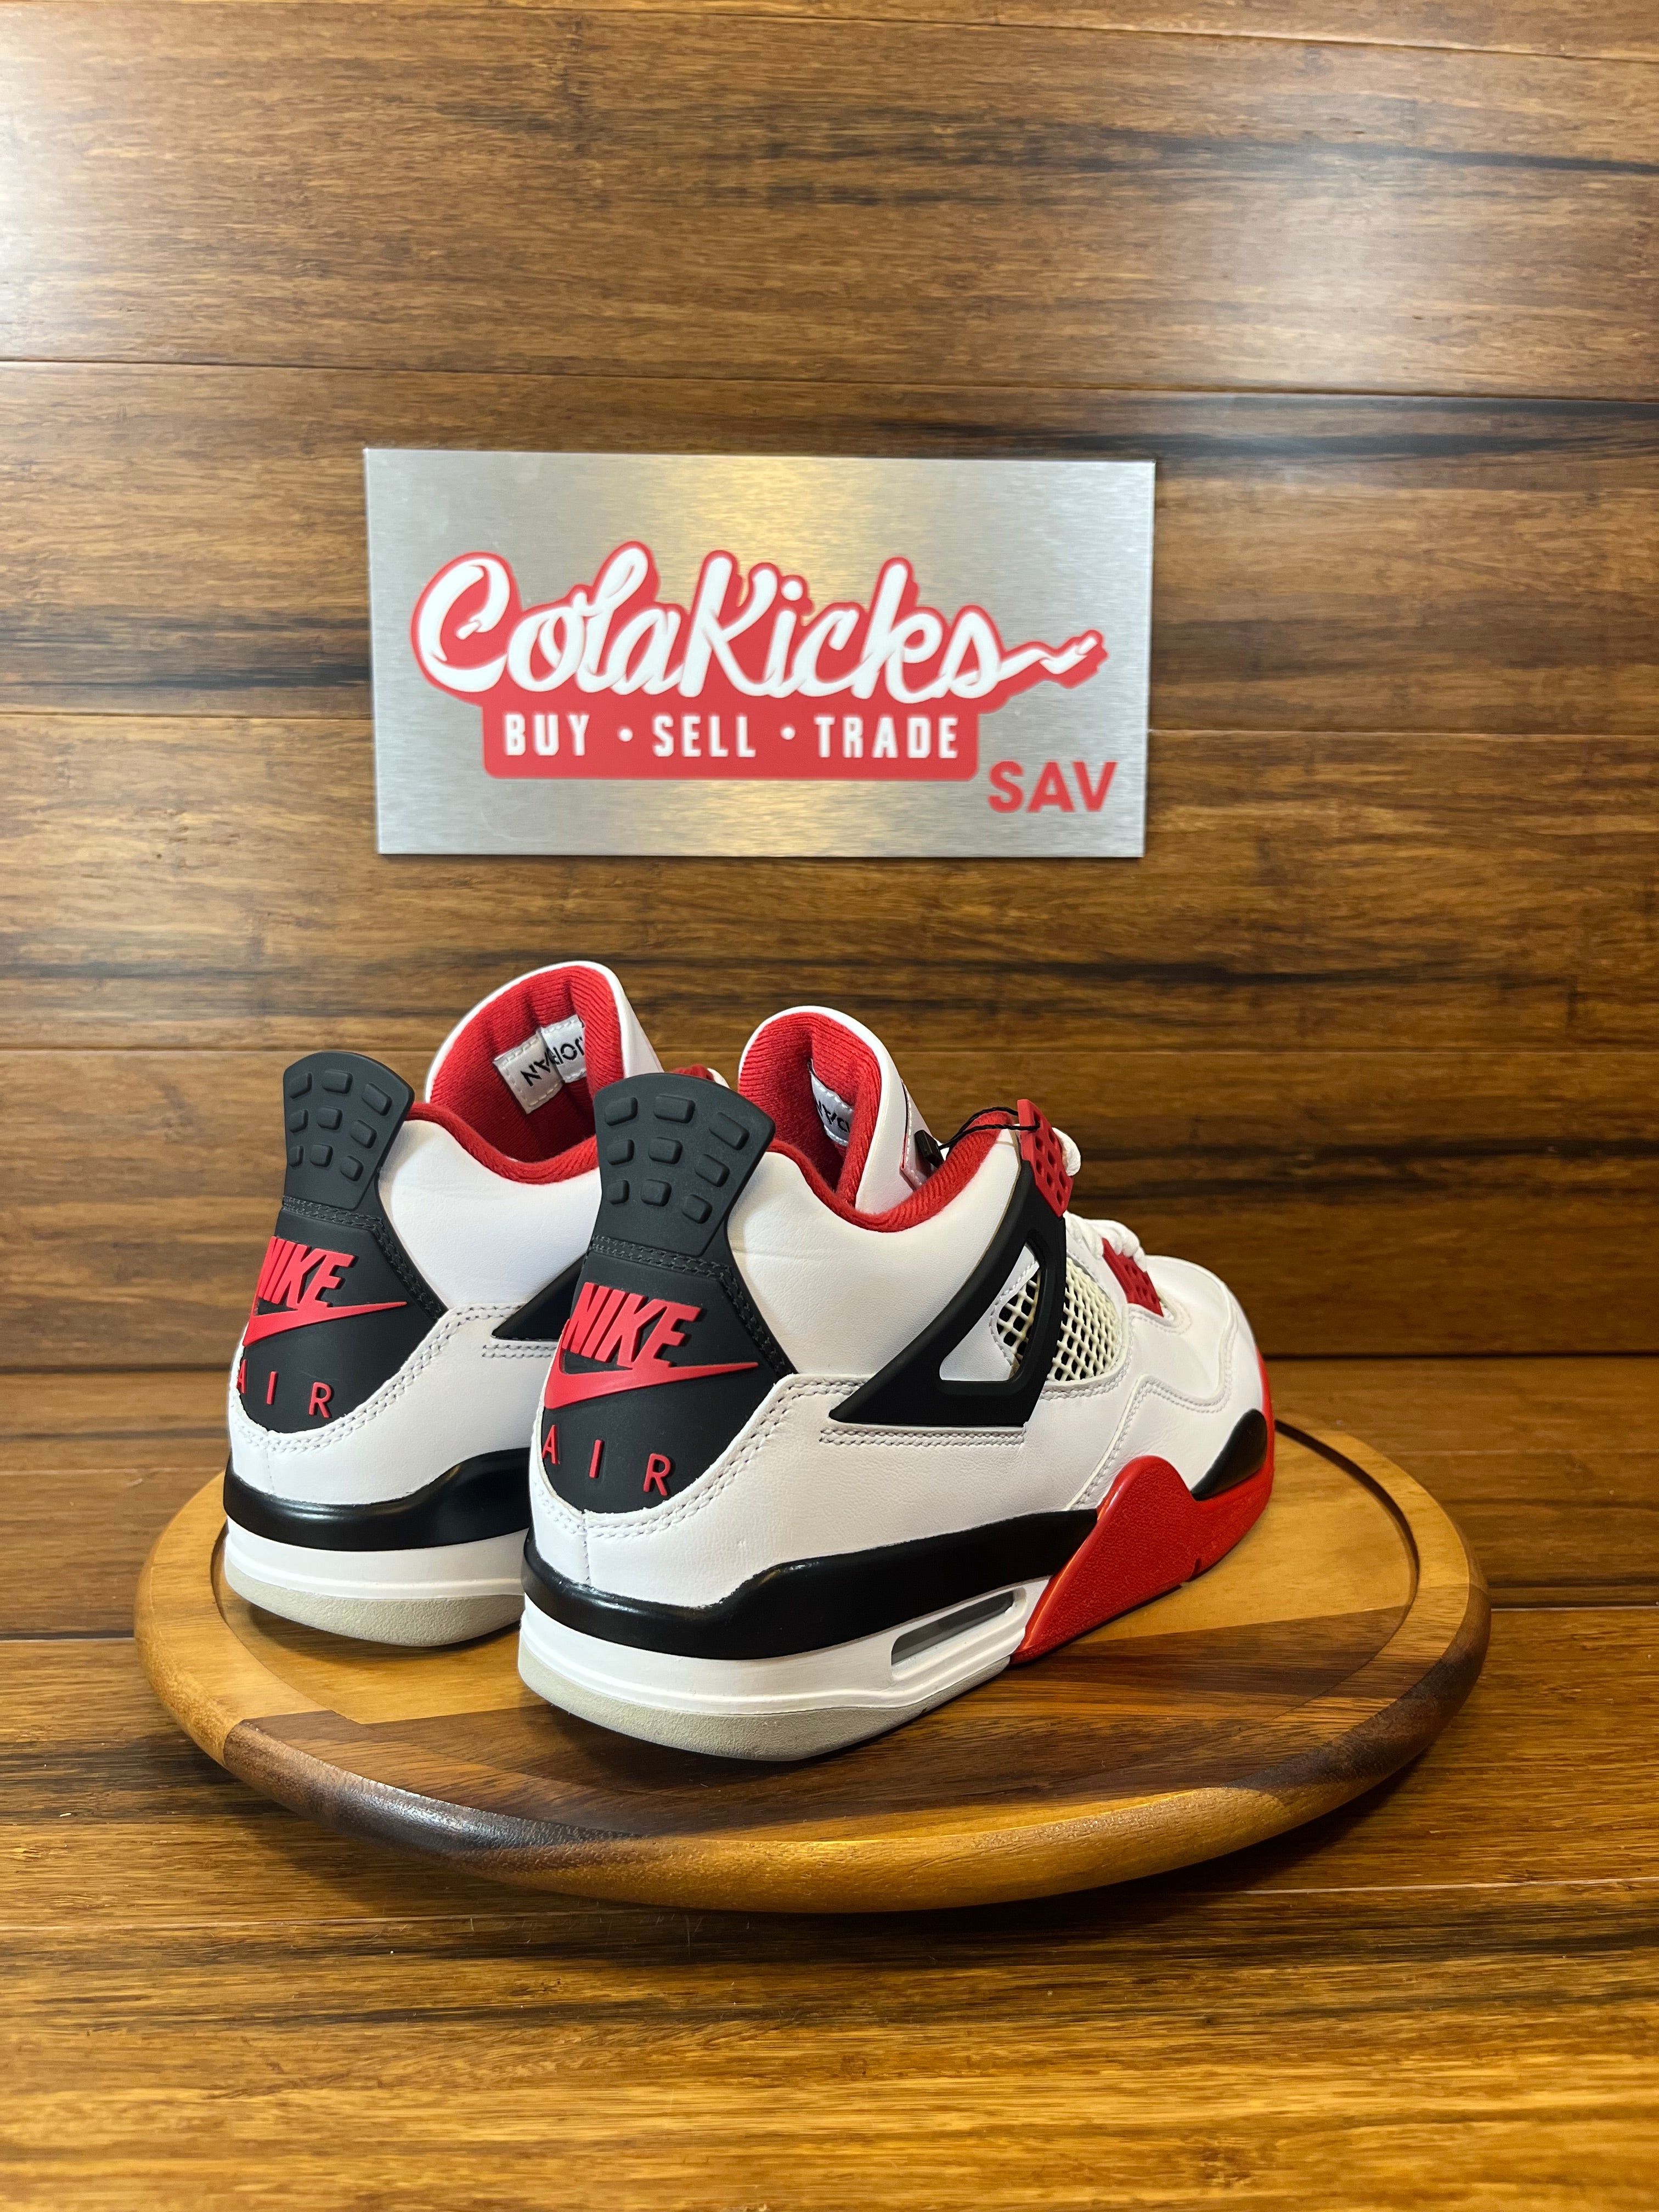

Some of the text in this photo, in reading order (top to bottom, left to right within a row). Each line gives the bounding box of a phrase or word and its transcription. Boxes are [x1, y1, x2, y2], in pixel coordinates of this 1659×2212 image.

[504, 713, 958, 759] BUY SELL TRADE
[988, 760, 1118, 814] SAV
[256, 1235, 356, 1309] NIKE
[561, 1282, 702, 1368] NIKE
[541, 1424, 672, 1497] AIR
